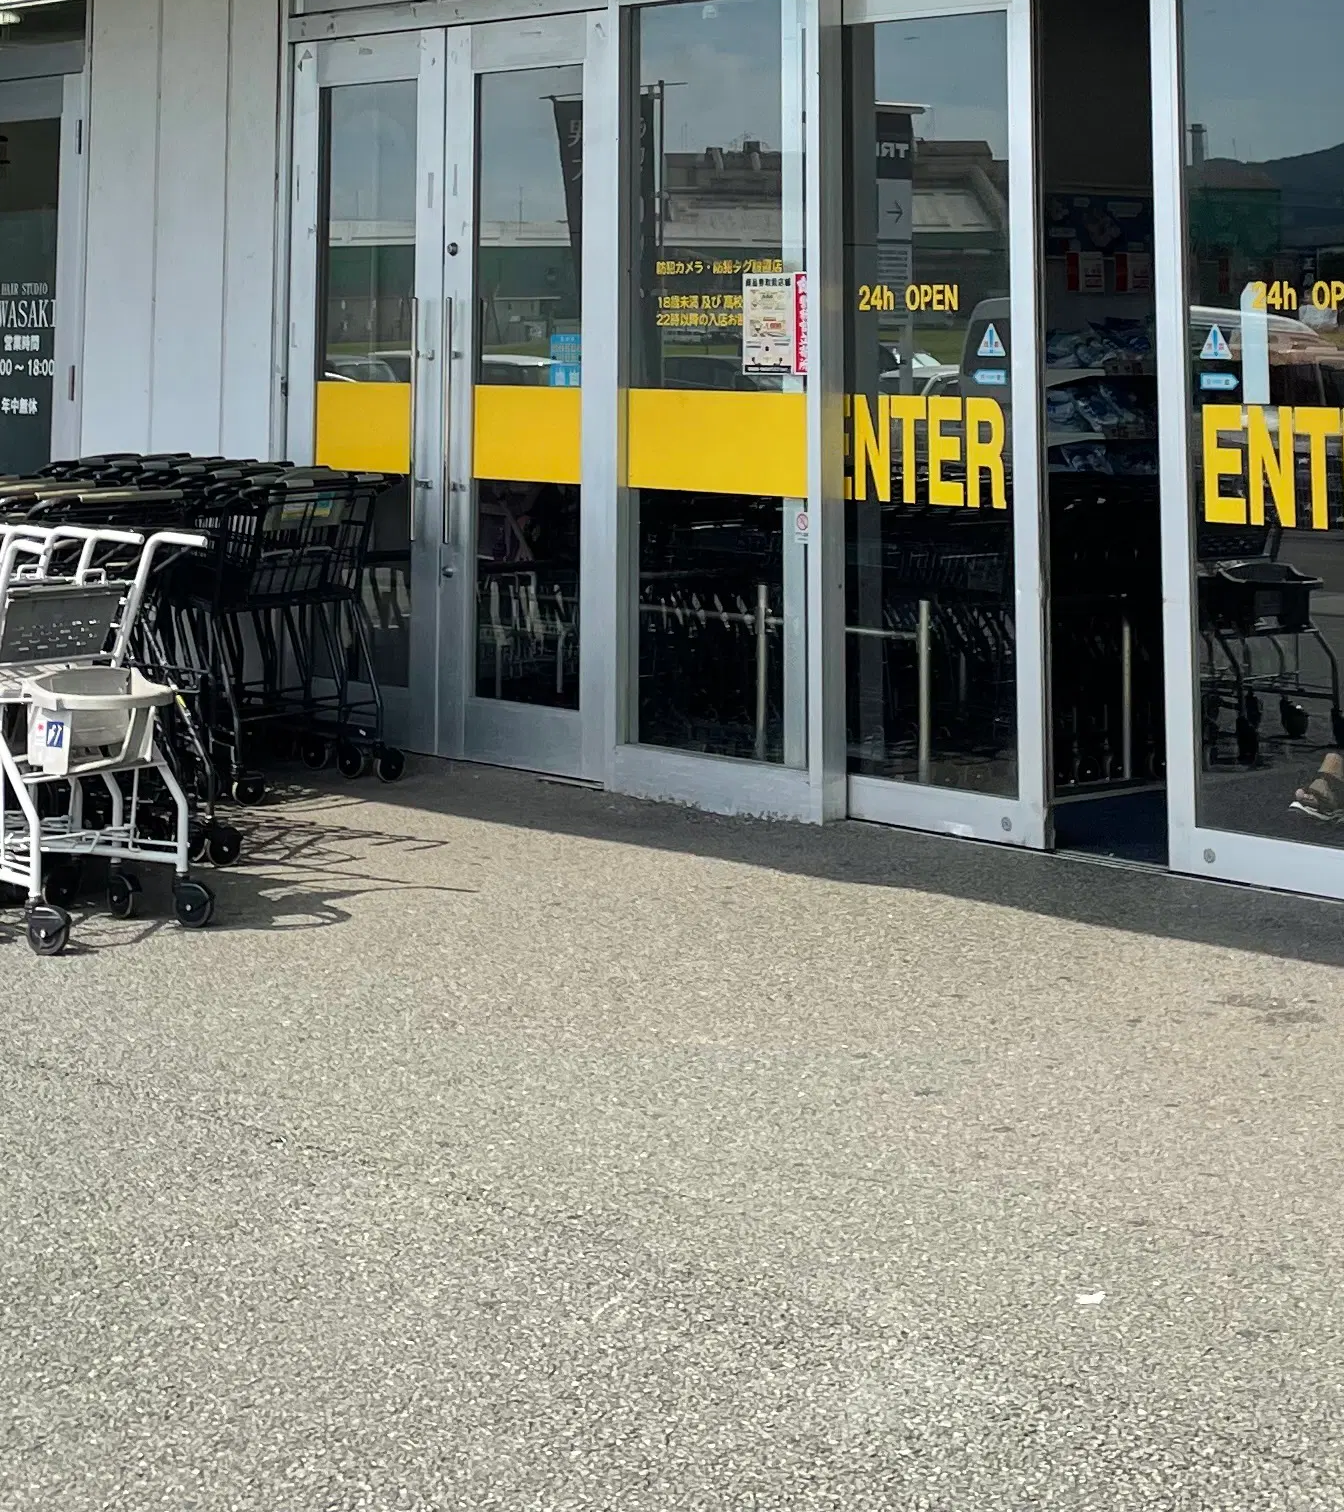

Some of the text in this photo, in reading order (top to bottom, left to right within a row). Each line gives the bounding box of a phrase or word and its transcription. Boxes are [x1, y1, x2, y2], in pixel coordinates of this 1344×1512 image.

[858, 284, 958, 311] 24h OPEN
[1252, 281, 1297, 310] 24h
